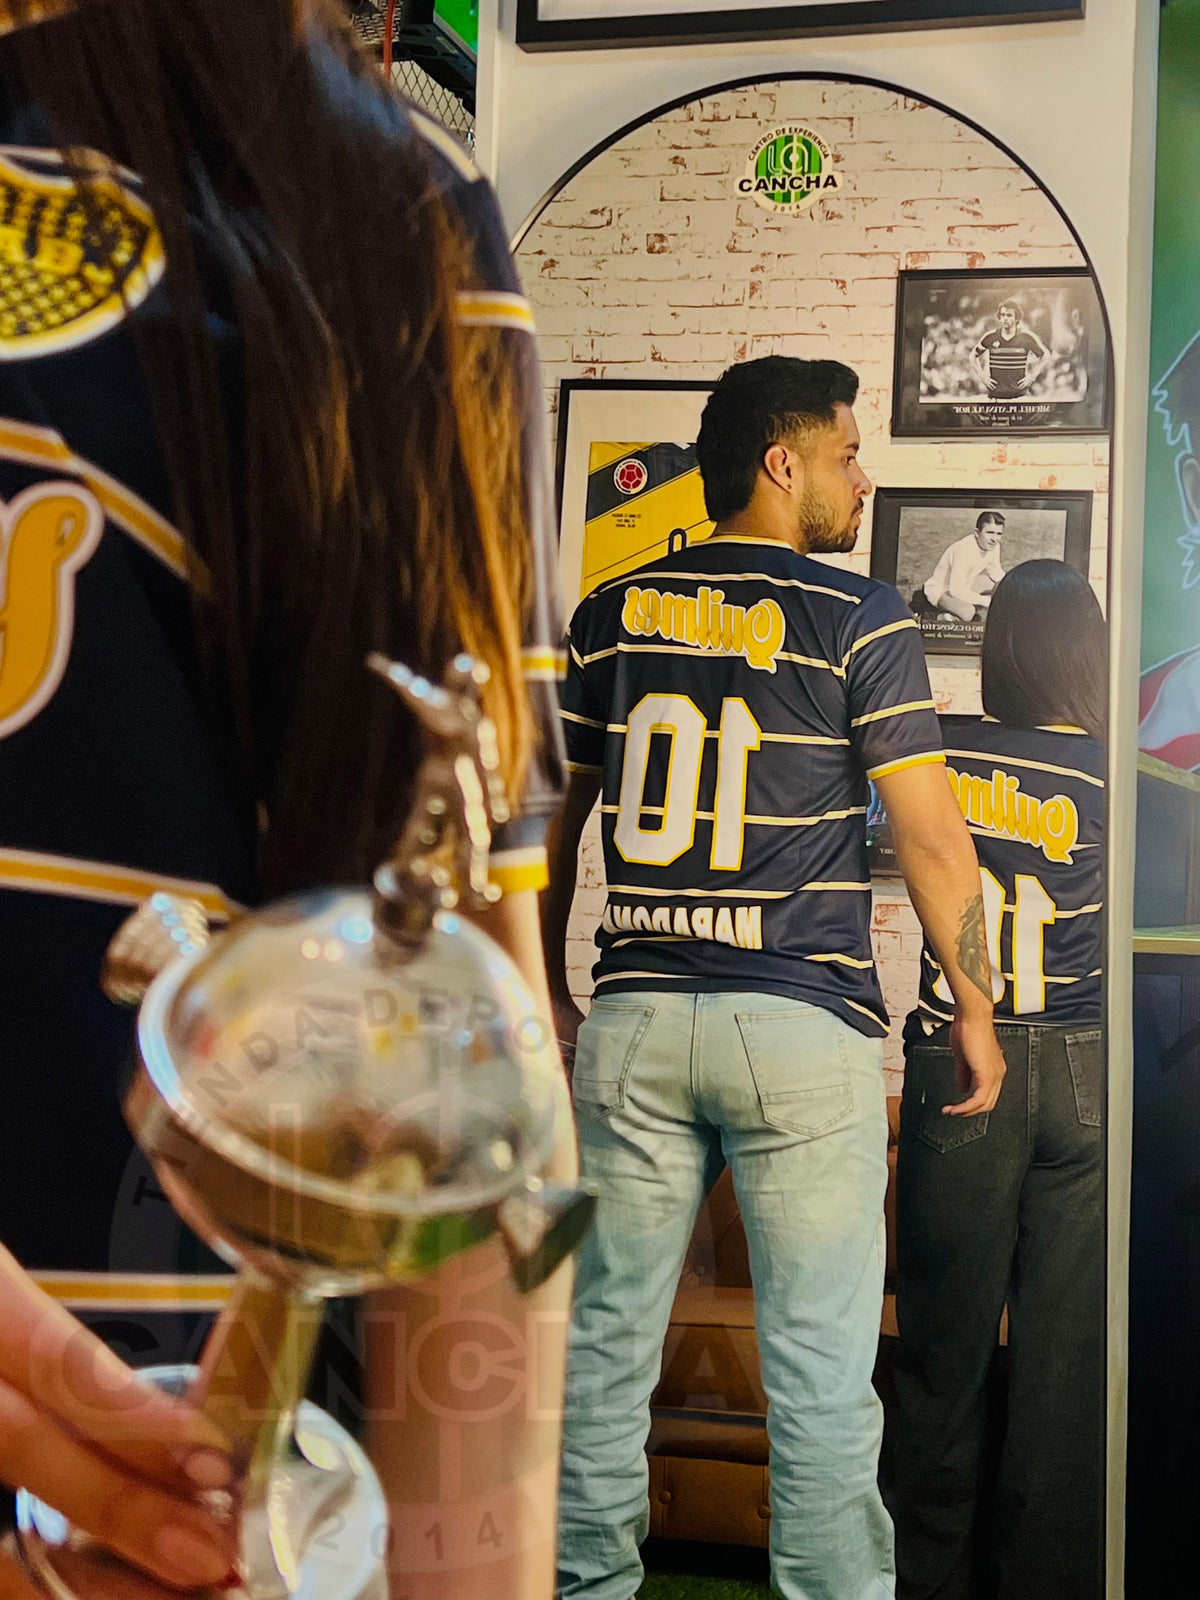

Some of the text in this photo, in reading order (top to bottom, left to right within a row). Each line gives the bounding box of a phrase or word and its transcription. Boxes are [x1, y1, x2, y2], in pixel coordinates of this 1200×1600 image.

[748, 127, 830, 161] CENTRO DE EXPERIENCIA
[738, 175, 838, 192] CANCHA
